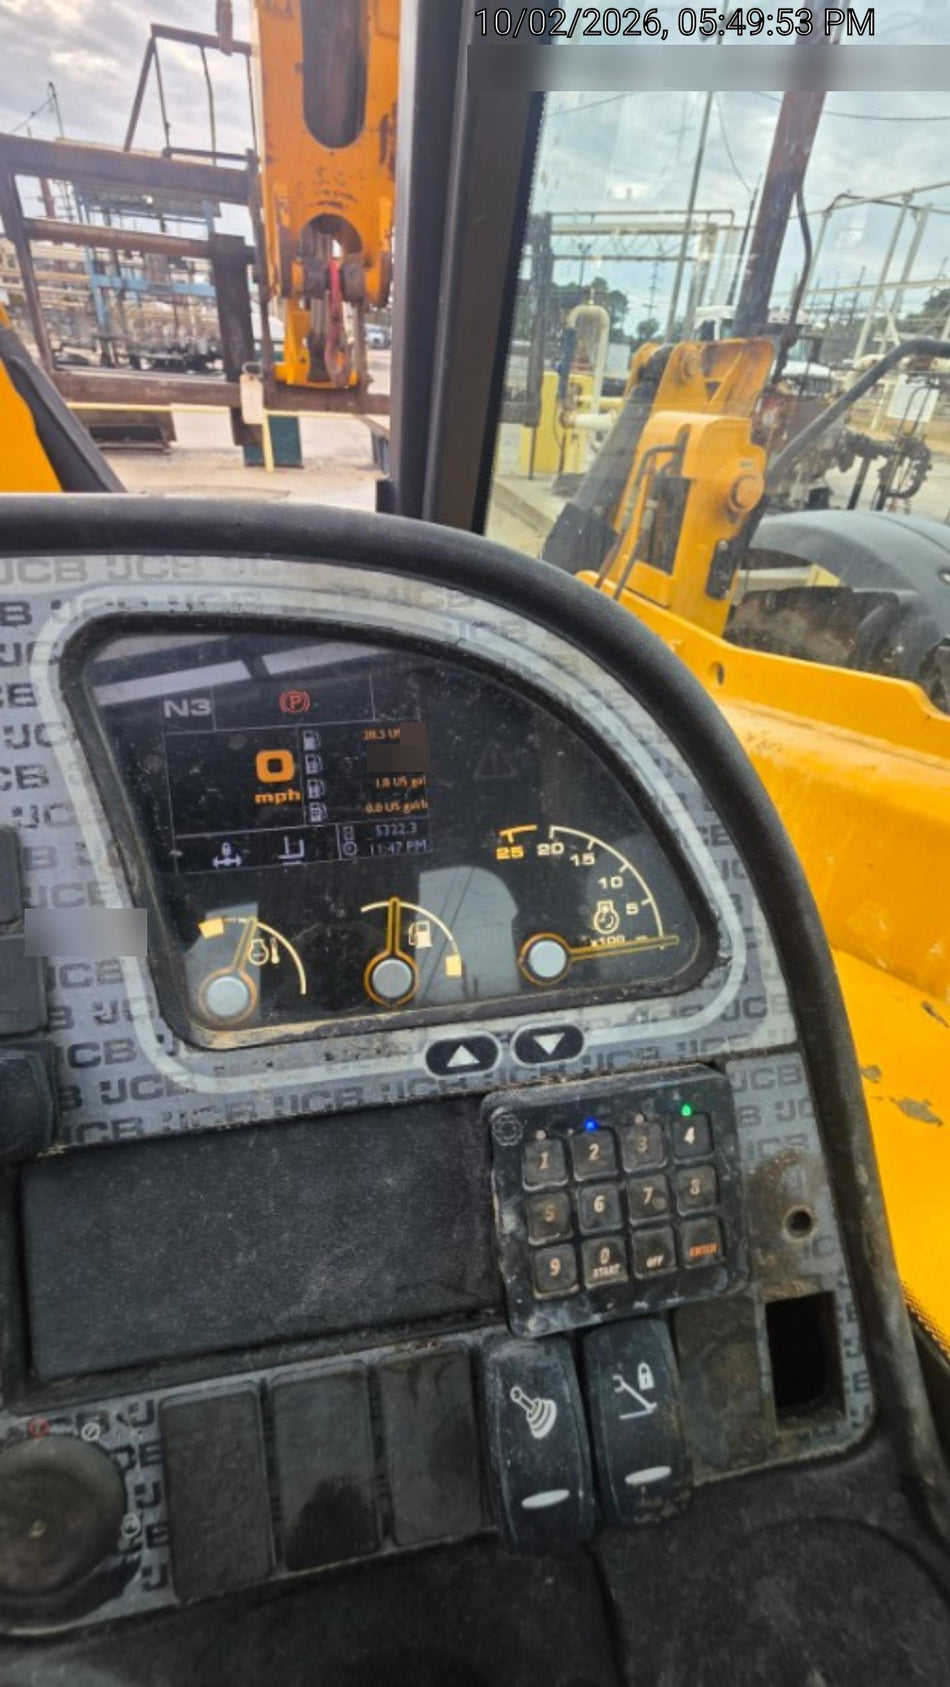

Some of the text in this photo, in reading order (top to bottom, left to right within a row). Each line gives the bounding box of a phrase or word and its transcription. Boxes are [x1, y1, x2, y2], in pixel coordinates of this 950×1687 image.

[163, 698, 212, 718] N3
[254, 789, 301, 805] mph
[406, 839, 428, 855] PM
[495, 846, 524, 860] 25
[537, 842, 565, 856] 20
[569, 852, 595, 867] 15
[598, 876, 624, 889] 10
[625, 902, 639, 915] 5
[539, 1126, 696, 1170] 1 2 3 4
[544, 1178, 701, 1221] 5 6 7 8
[549, 1248, 610, 1276] 9 0
